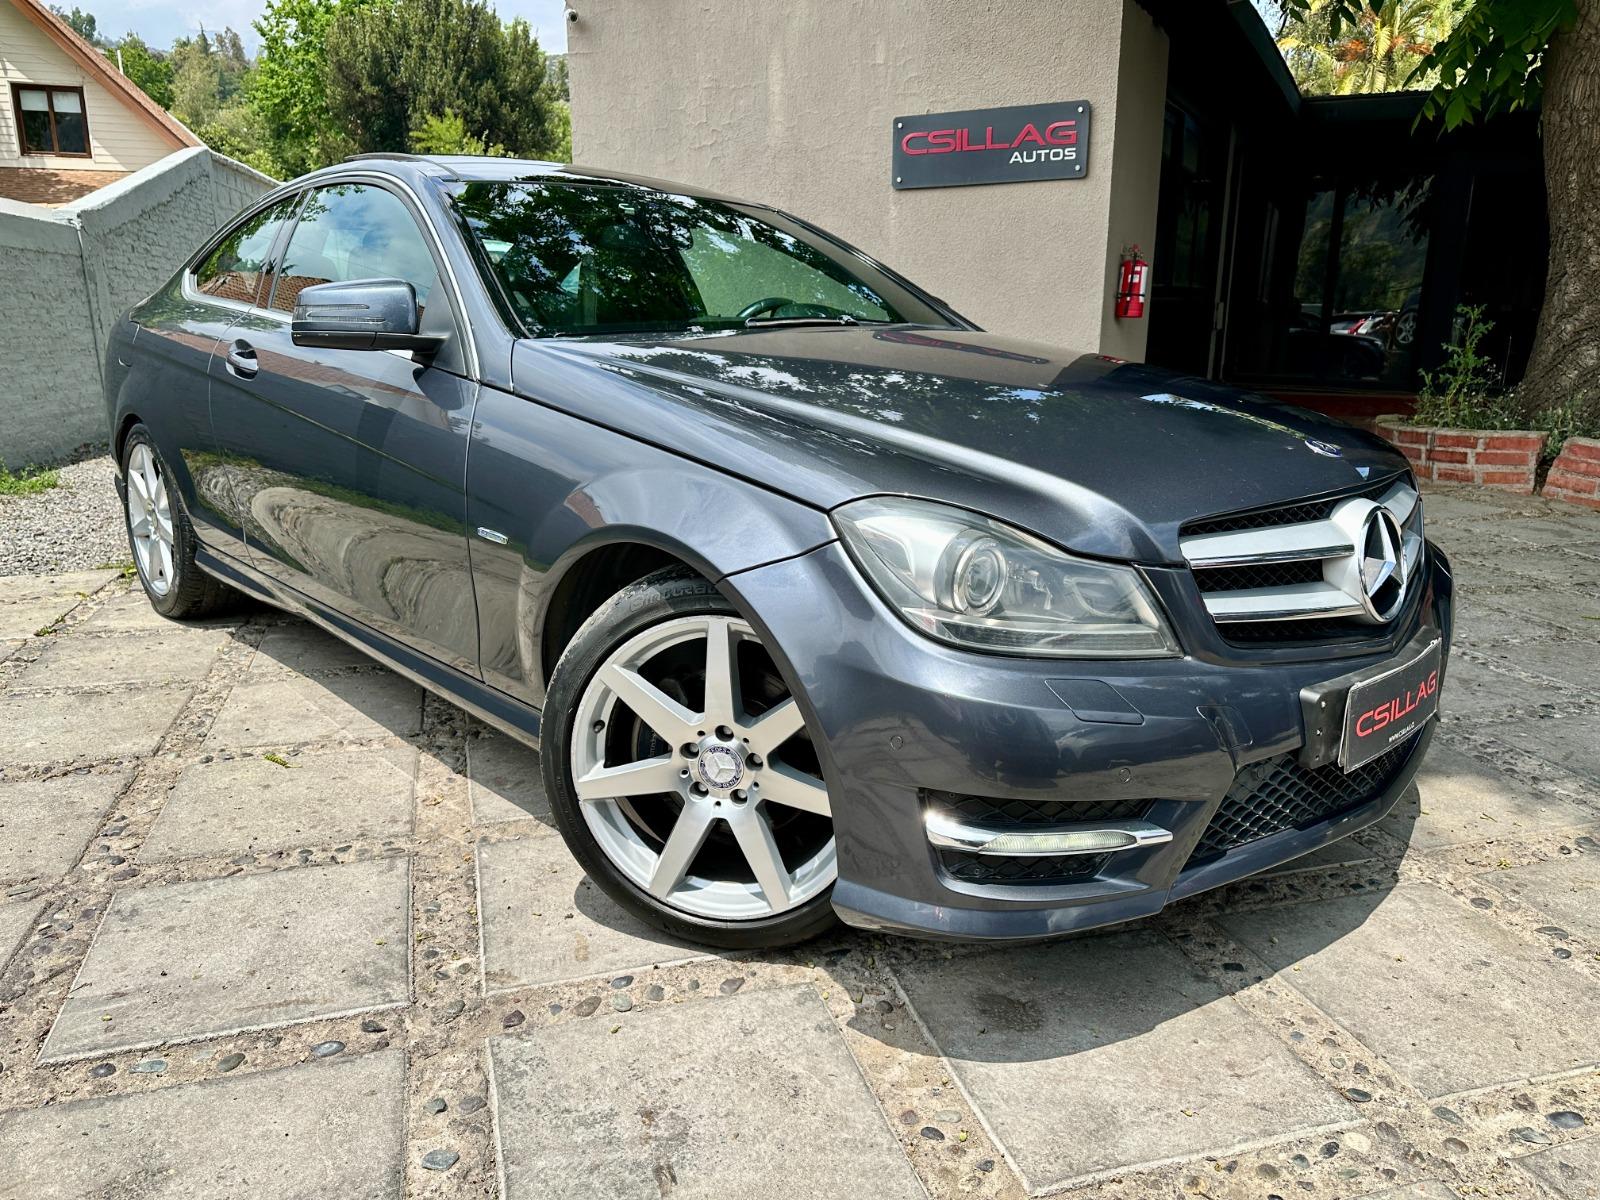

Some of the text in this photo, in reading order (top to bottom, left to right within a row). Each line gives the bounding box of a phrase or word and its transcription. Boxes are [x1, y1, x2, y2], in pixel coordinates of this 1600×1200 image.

[901, 120, 1078, 156] CSILLAG
[1009, 147, 1077, 164] AUTOS
[1356, 670, 1437, 737] CSILLAG
